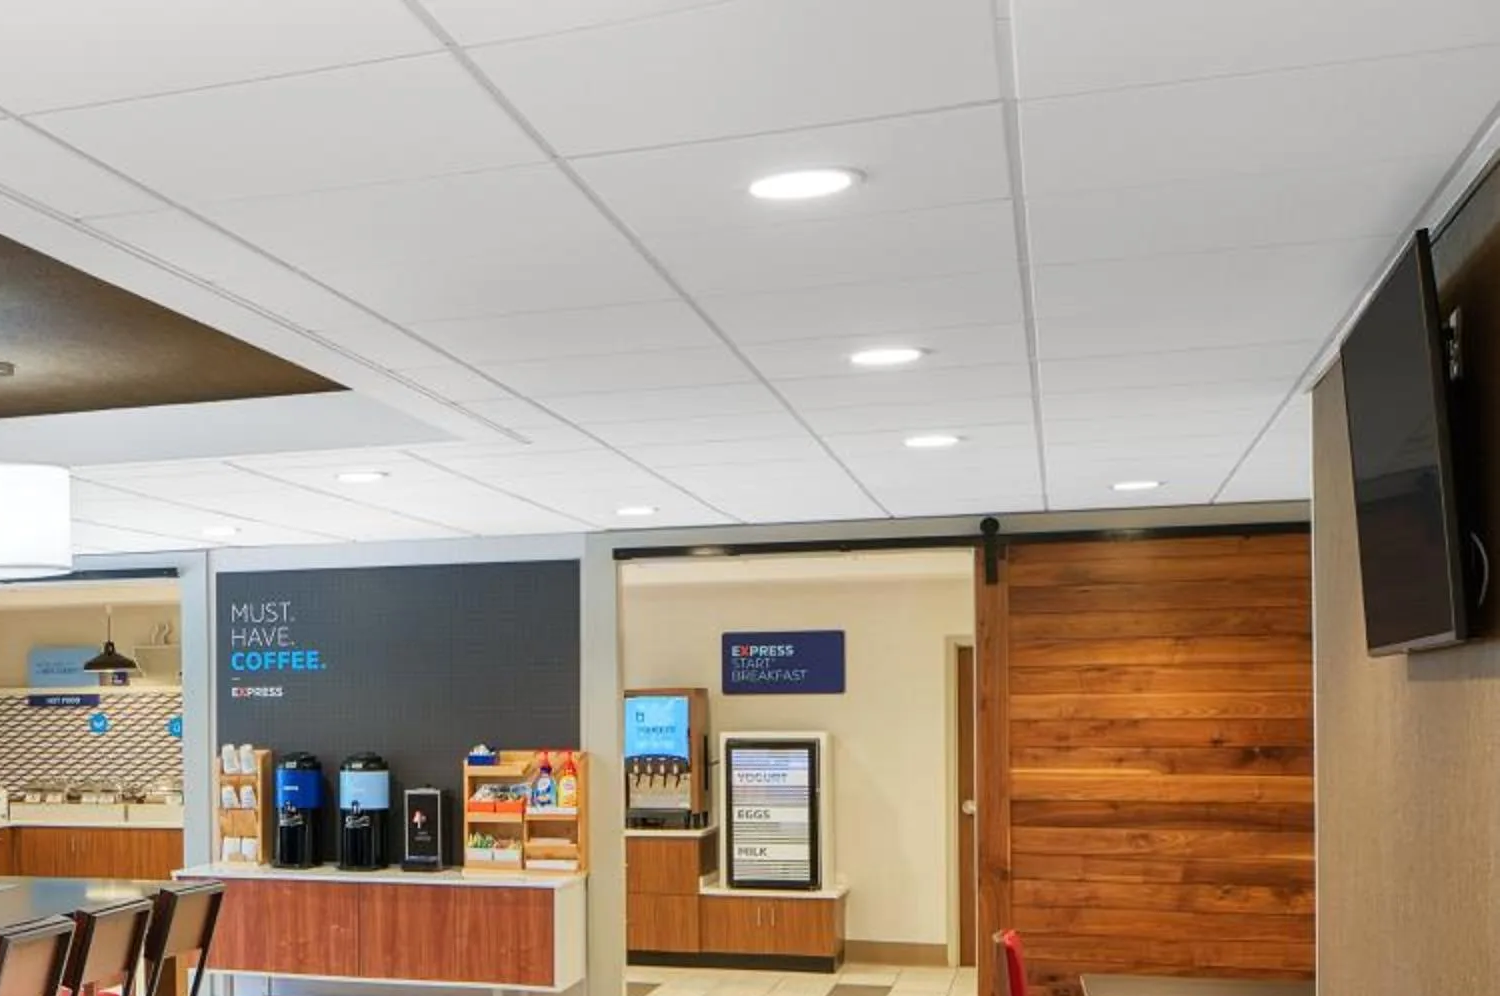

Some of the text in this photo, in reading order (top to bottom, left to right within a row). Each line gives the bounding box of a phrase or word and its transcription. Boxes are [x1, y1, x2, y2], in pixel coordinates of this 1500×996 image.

[231, 601, 295, 622] MUST.
[231, 627, 295, 647] HAVE.
[731, 645, 794, 657] EXPRESS
[231, 651, 327, 671] COFFEE.
[731, 669, 808, 681] BREAKFAST
[231, 687, 283, 697] EXPRESS
[737, 772, 788, 783] YOGURT
[737, 809, 771, 819] EGGS
[737, 847, 767, 857] MILK
